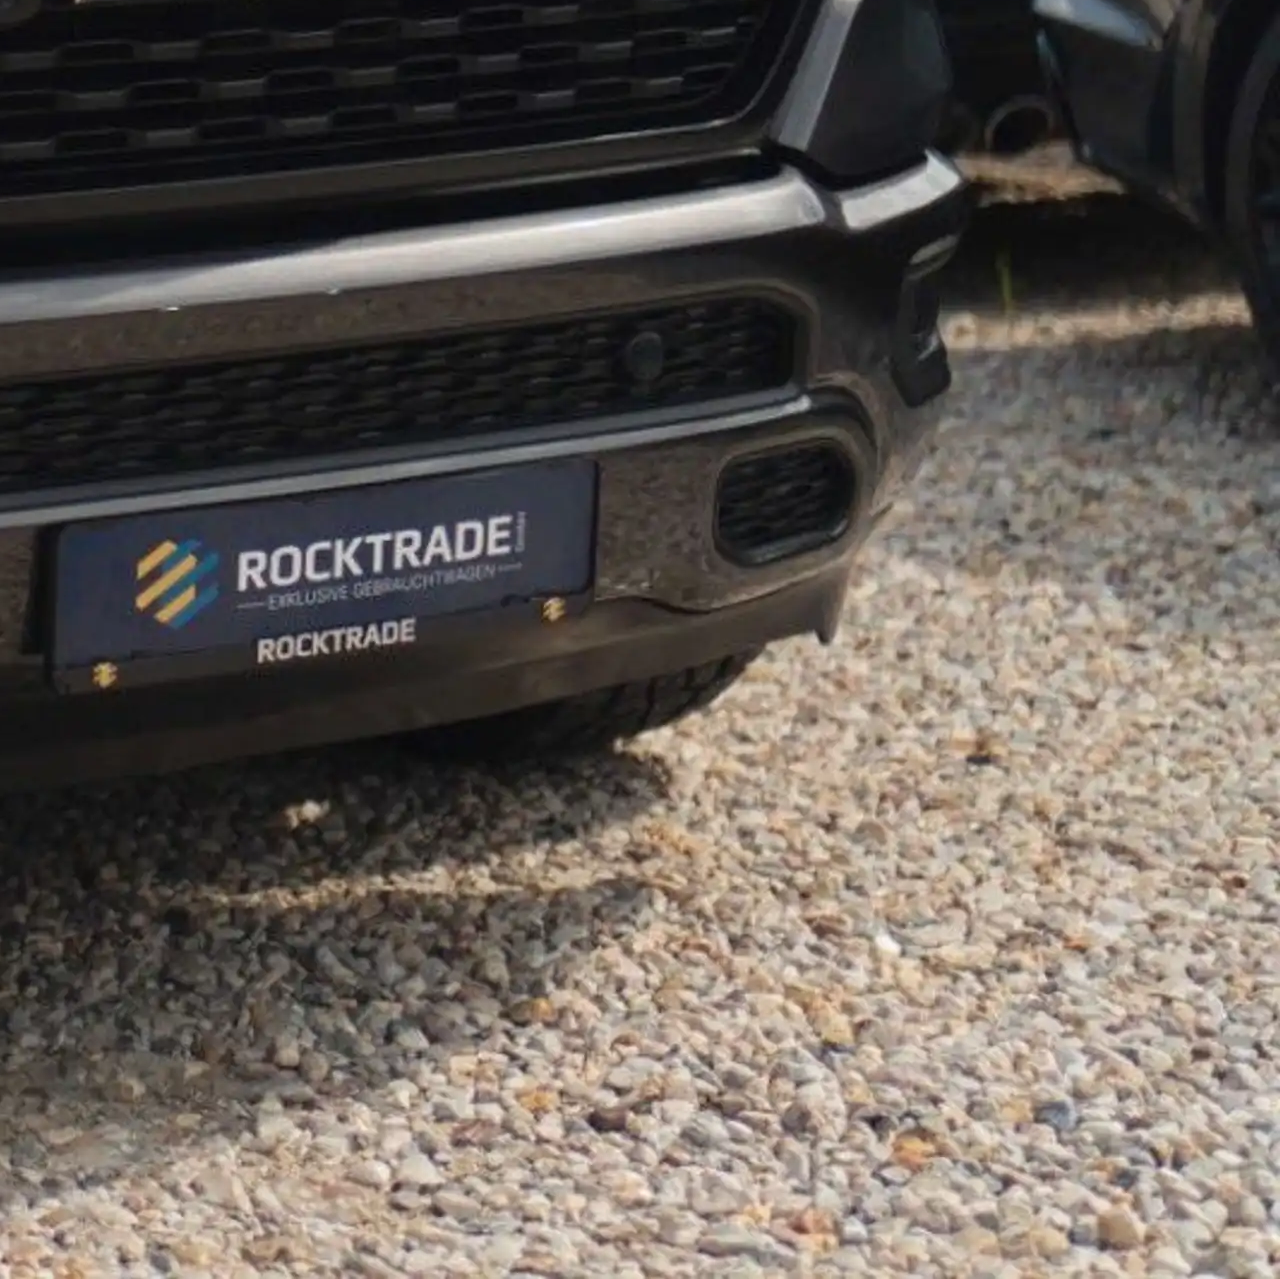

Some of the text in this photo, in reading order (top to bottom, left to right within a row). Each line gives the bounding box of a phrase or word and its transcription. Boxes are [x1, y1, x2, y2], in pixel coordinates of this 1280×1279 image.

[237, 514, 513, 592] ROCKTRADE
[268, 564, 497, 610] EXKLUSIVE GEBRAUCHTWAGEN
[257, 618, 416, 663] ROCKTRADE
